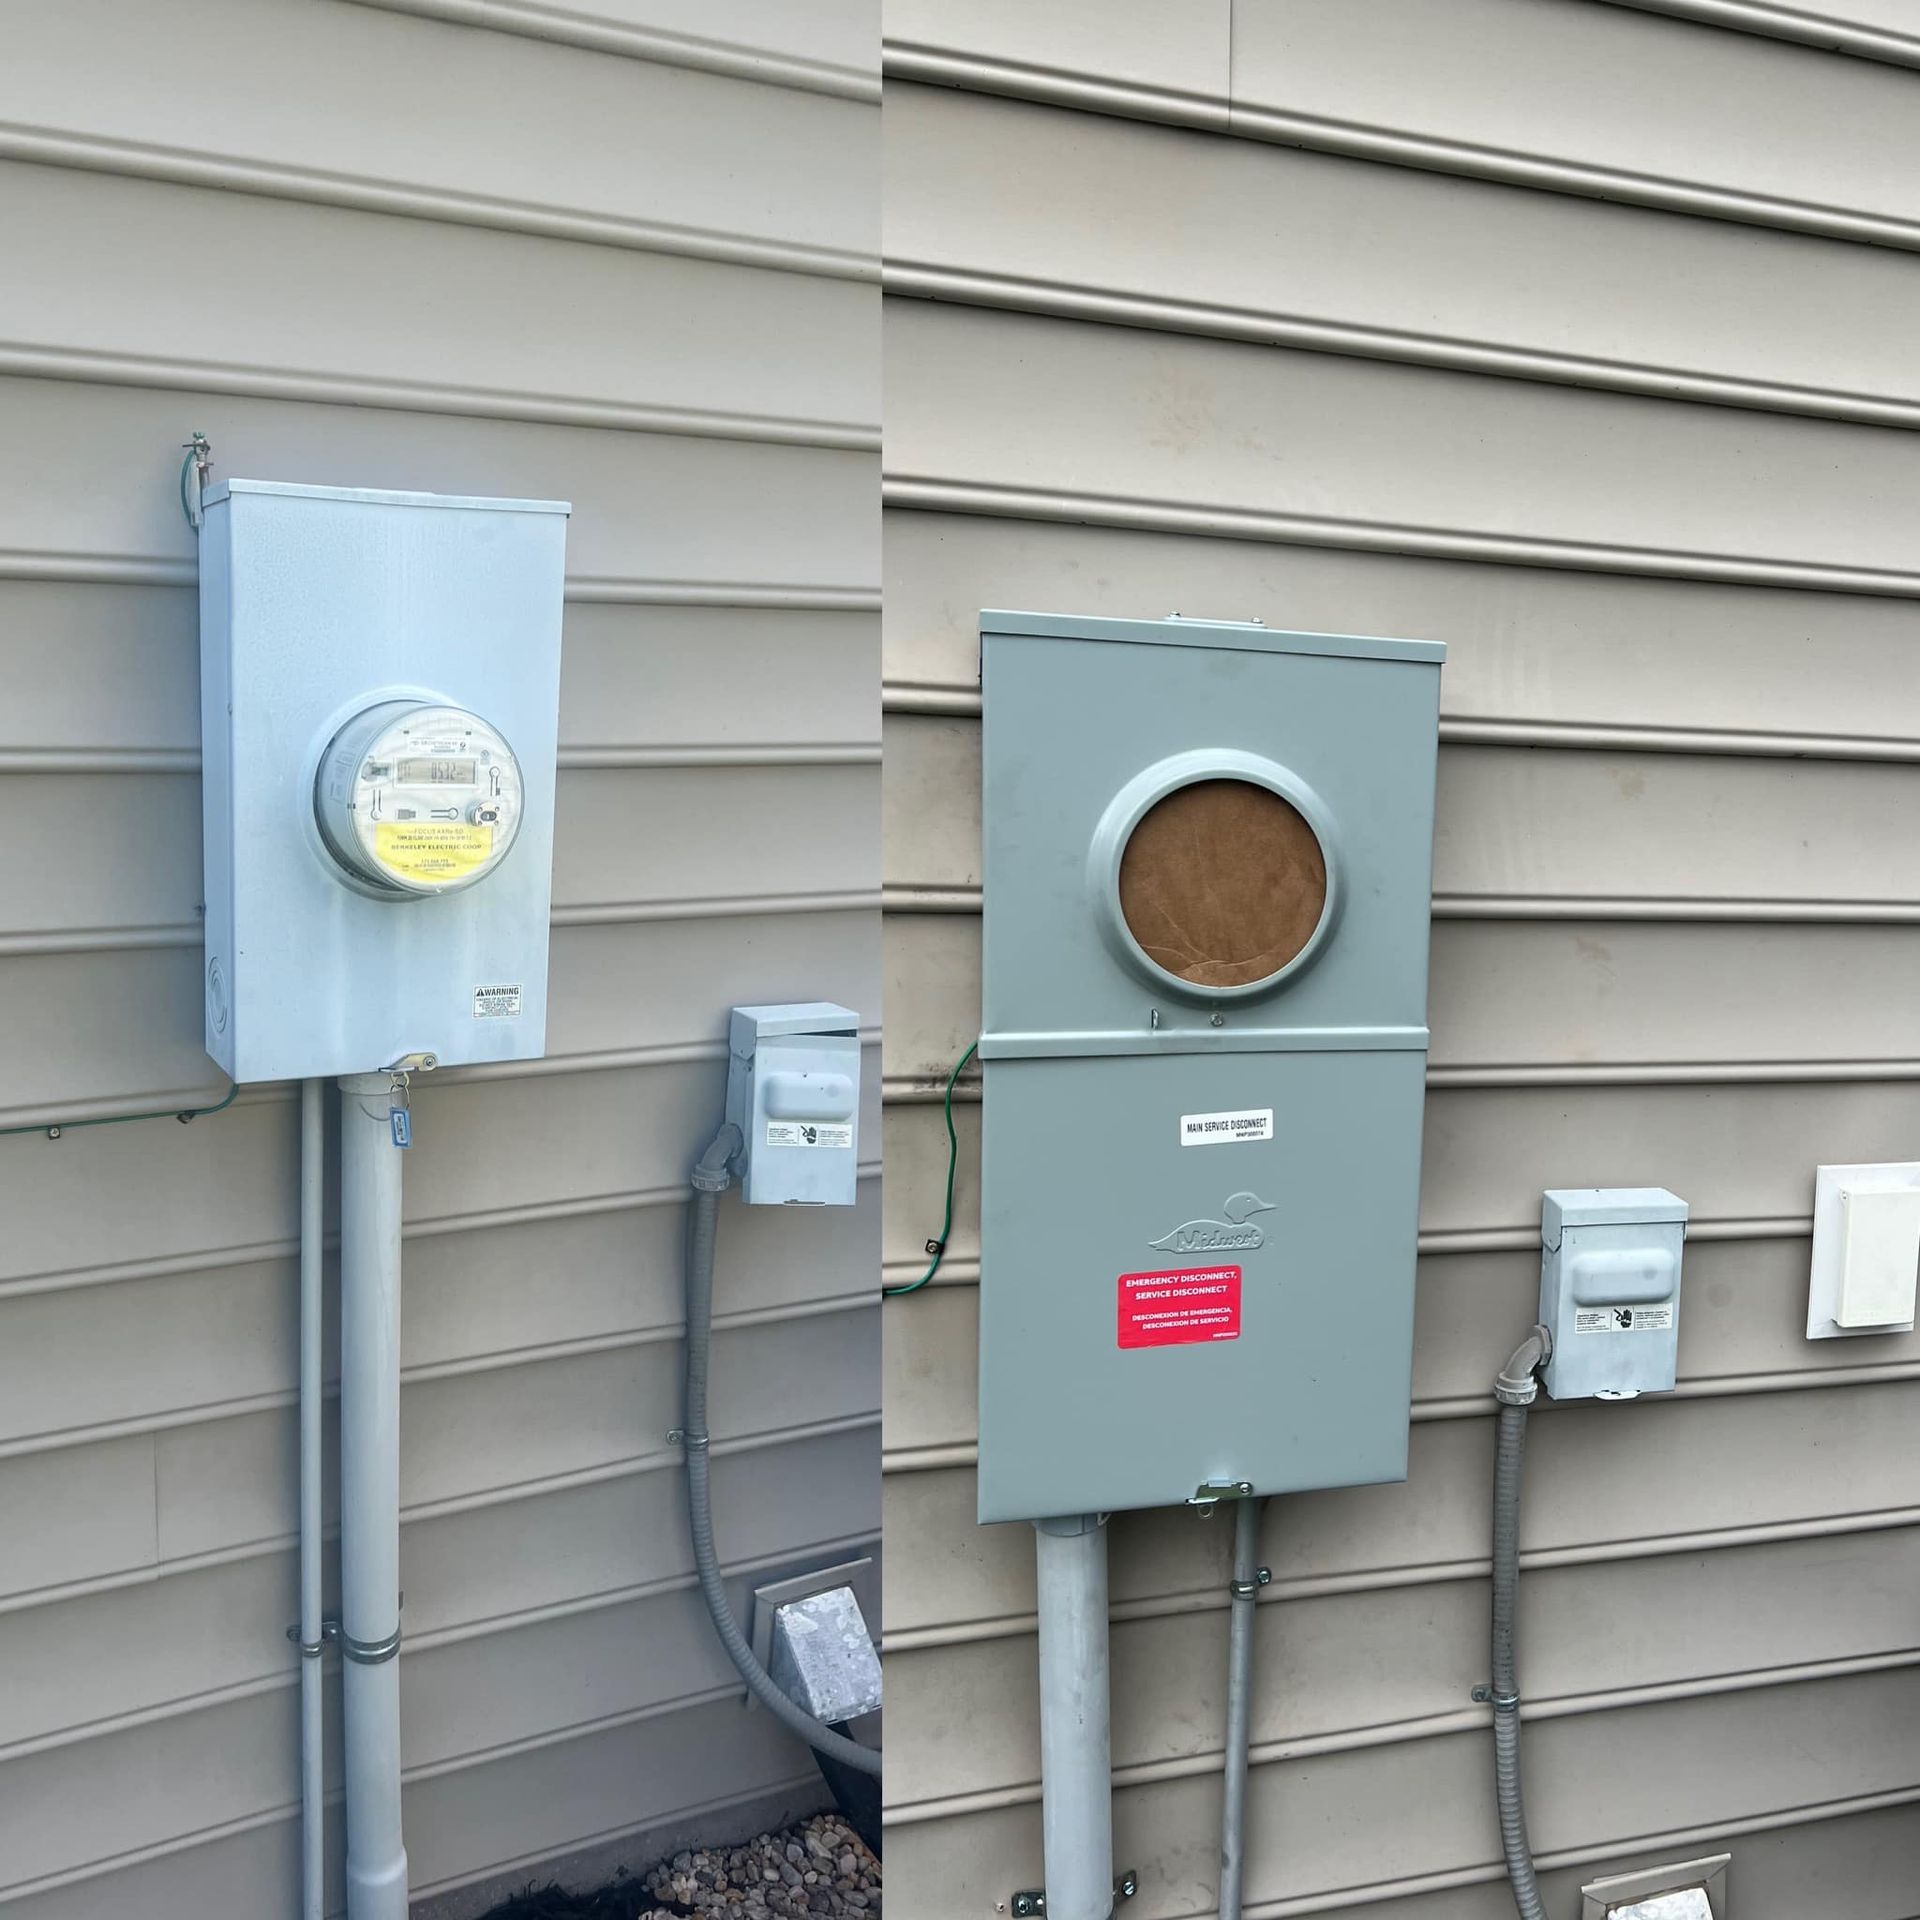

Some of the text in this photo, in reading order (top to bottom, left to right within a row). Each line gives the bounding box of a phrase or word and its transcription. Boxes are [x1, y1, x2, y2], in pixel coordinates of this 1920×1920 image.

[484, 987, 519, 997] WARNING
[1187, 1117, 1267, 1133] MAIN SERVICE DISCONNECT
[1176, 1229, 1261, 1251] Midwest
[1126, 1271, 1237, 1287] EMERGENCY DISCONNECT,
[1135, 1285, 1228, 1300] SERVICE DISCONNECT
[1132, 1307, 1232, 1321] DESCONEXION DE EMERGENCIA,
[1142, 1316, 1229, 1330] DESCONEXION DE SERVICIO
